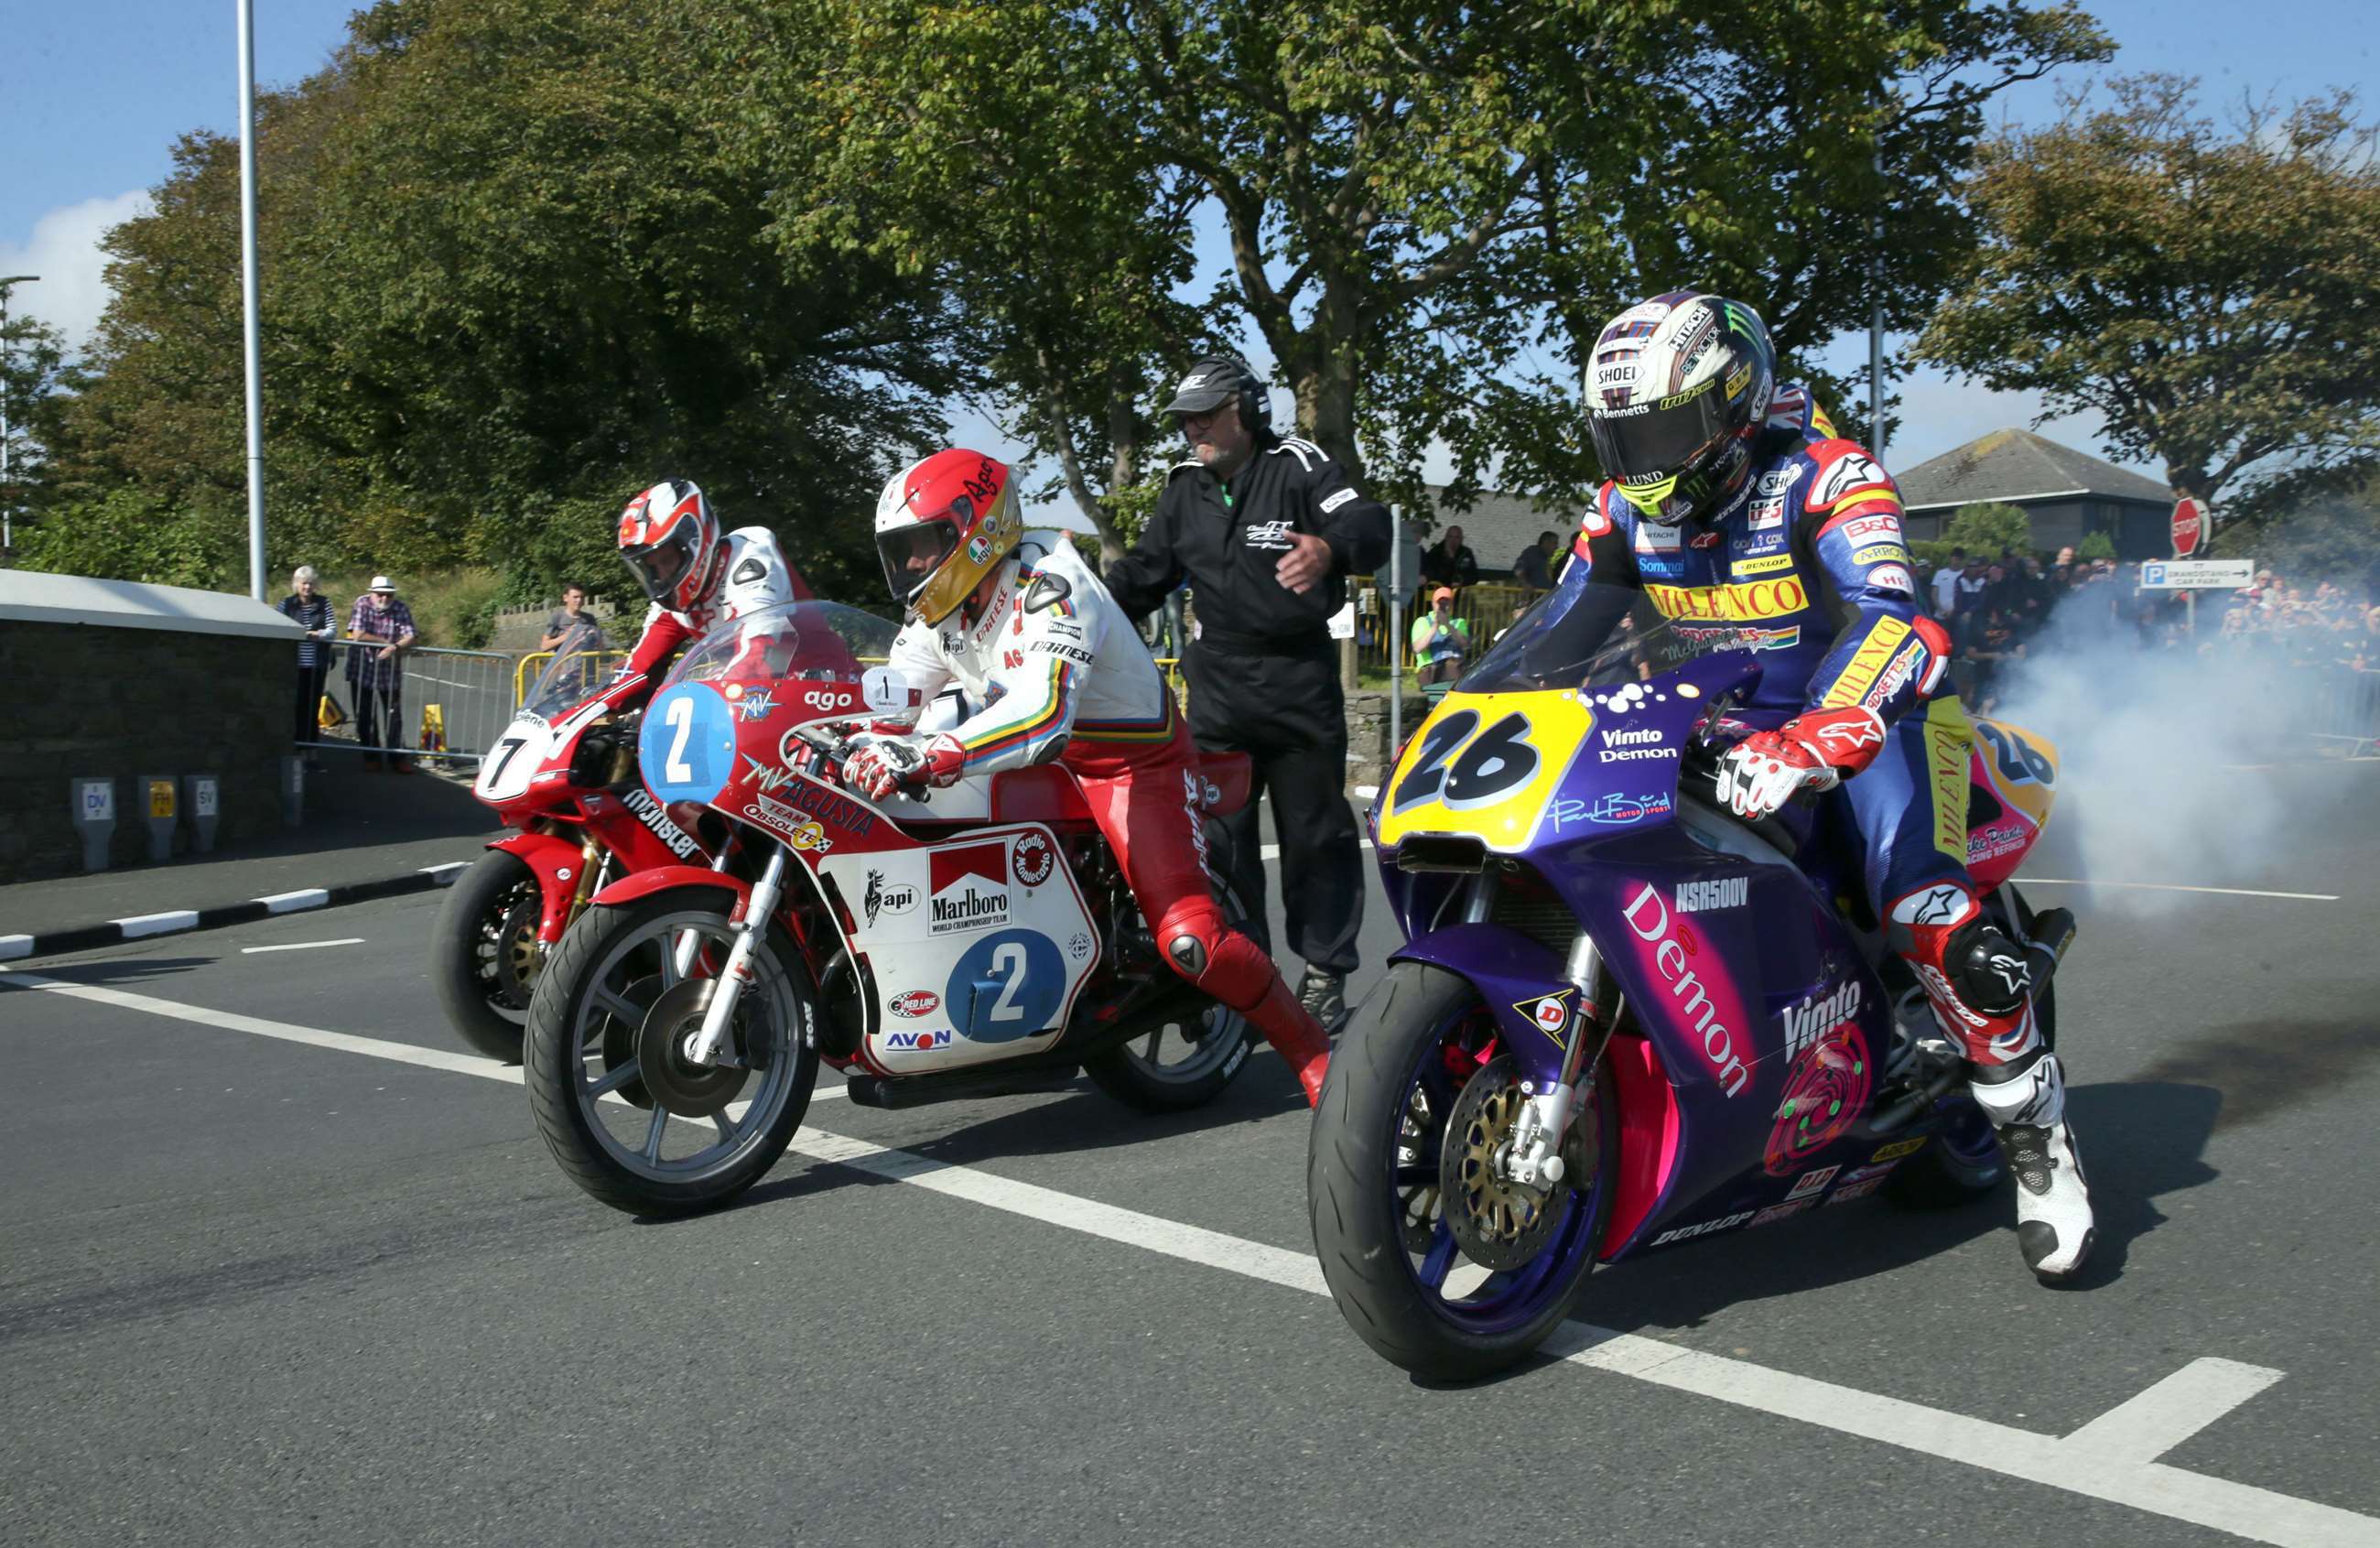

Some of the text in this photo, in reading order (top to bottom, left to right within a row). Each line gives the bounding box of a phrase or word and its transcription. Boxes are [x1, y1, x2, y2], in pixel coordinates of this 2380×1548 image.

[1669, 306, 1711, 351] HITACHI
[1598, 366, 1636, 384] SHOEI
[1602, 404, 1650, 419] Bennetts
[1625, 471, 1664, 486] LUND
[1844, 516, 1900, 538] B&C
[976, 545, 992, 564] agv
[1745, 558, 1787, 569] DUNLOP
[1049, 622, 1082, 639] CHAMPION
[1030, 641, 1095, 666] DAINESE
[882, 676, 890, 699] 1
[804, 688, 852, 711] ago
[665, 697, 694, 784] 2
[1601, 728, 1663, 750] Vimto
[487, 738, 529, 793] 7
[1392, 709, 1541, 816] 26
[1598, 746, 1678, 763] Demon
[1976, 722, 2056, 786] 26
[745, 806, 817, 844] OBSOLETE
[768, 804, 806, 824] TEAM
[1016, 833, 1046, 855] Radio
[883, 888, 913, 910] api
[931, 888, 1008, 922] Marlboro
[1675, 877, 1748, 914] NSR500V
[932, 915, 1008, 933] WORLD CHAMPIONSHIP TEAM
[990, 942, 1028, 1022] 2
[1621, 882, 1748, 1099] Demon
[903, 997, 937, 1008] RED LINE
[1782, 980, 1862, 1065] Vimto
[1650, 1211, 1756, 1247] DUNLOP
